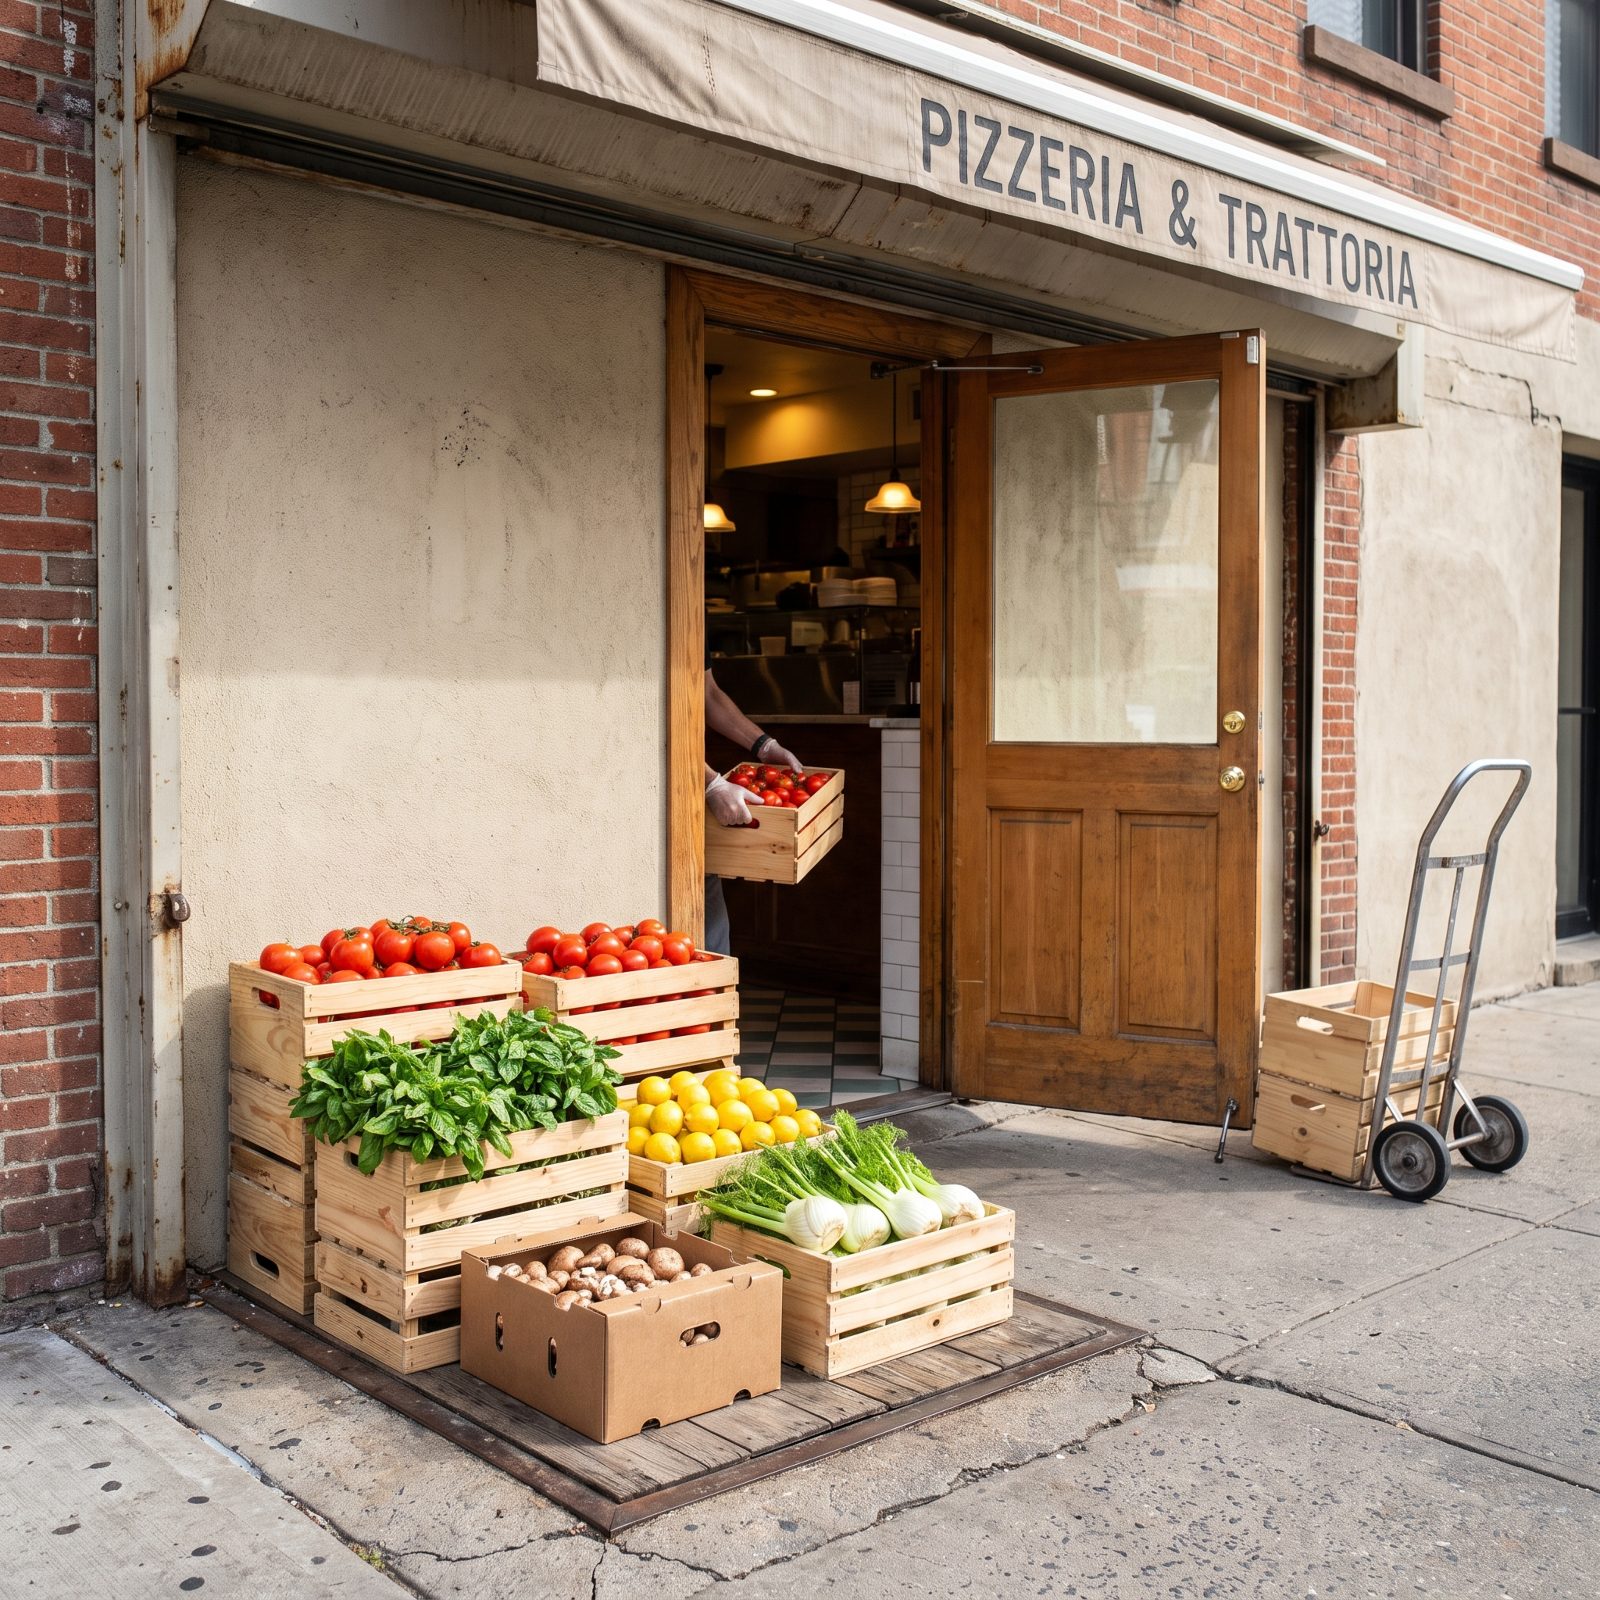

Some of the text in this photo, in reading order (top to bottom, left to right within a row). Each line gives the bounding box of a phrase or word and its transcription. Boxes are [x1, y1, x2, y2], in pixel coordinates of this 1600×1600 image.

[921, 97, 1419, 310] PIZZERIA & TRATTORIA
